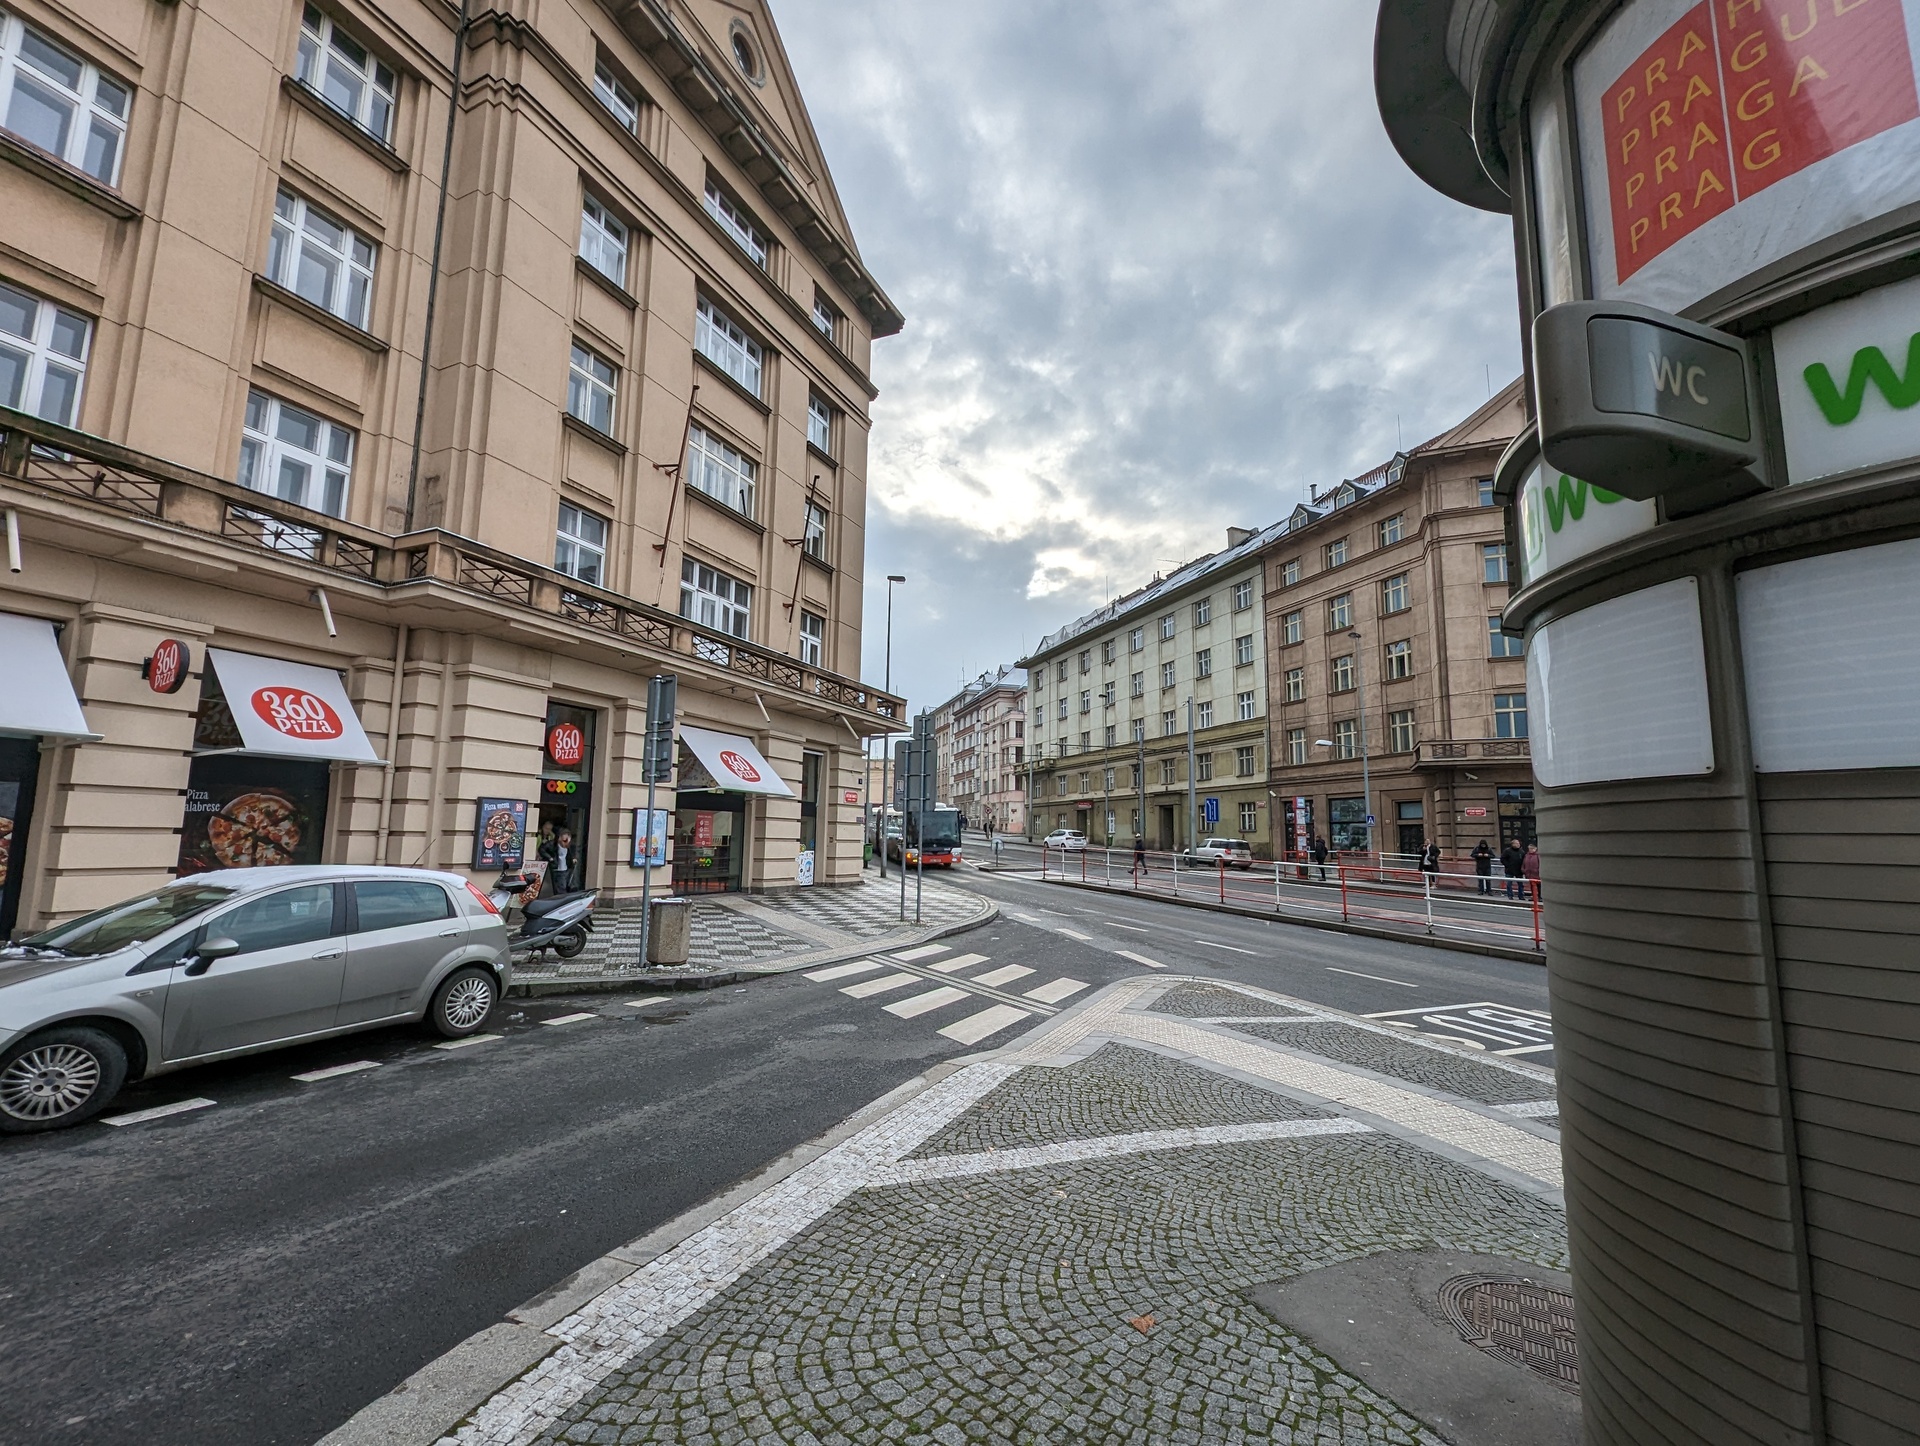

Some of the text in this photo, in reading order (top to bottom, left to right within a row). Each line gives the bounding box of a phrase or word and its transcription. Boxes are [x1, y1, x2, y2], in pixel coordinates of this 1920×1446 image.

[1617, 30, 1707, 123] PRA
[1621, 74, 1712, 165] PRA
[1625, 54, 1829, 209] PRA GA
[1630, 128, 1781, 254] PRA G
[1648, 351, 1709, 405] WC
[156, 643, 178, 674] 360
[153, 669, 175, 689] Pizza
[261, 691, 325, 720] 360
[274, 717, 336, 733] Pizza
[555, 728, 580, 750] 360
[555, 748, 580, 760] Pizza
[722, 752, 750, 772] 360
[185, 801, 221, 812] alabrese
[187, 789, 209, 800] Pizza
